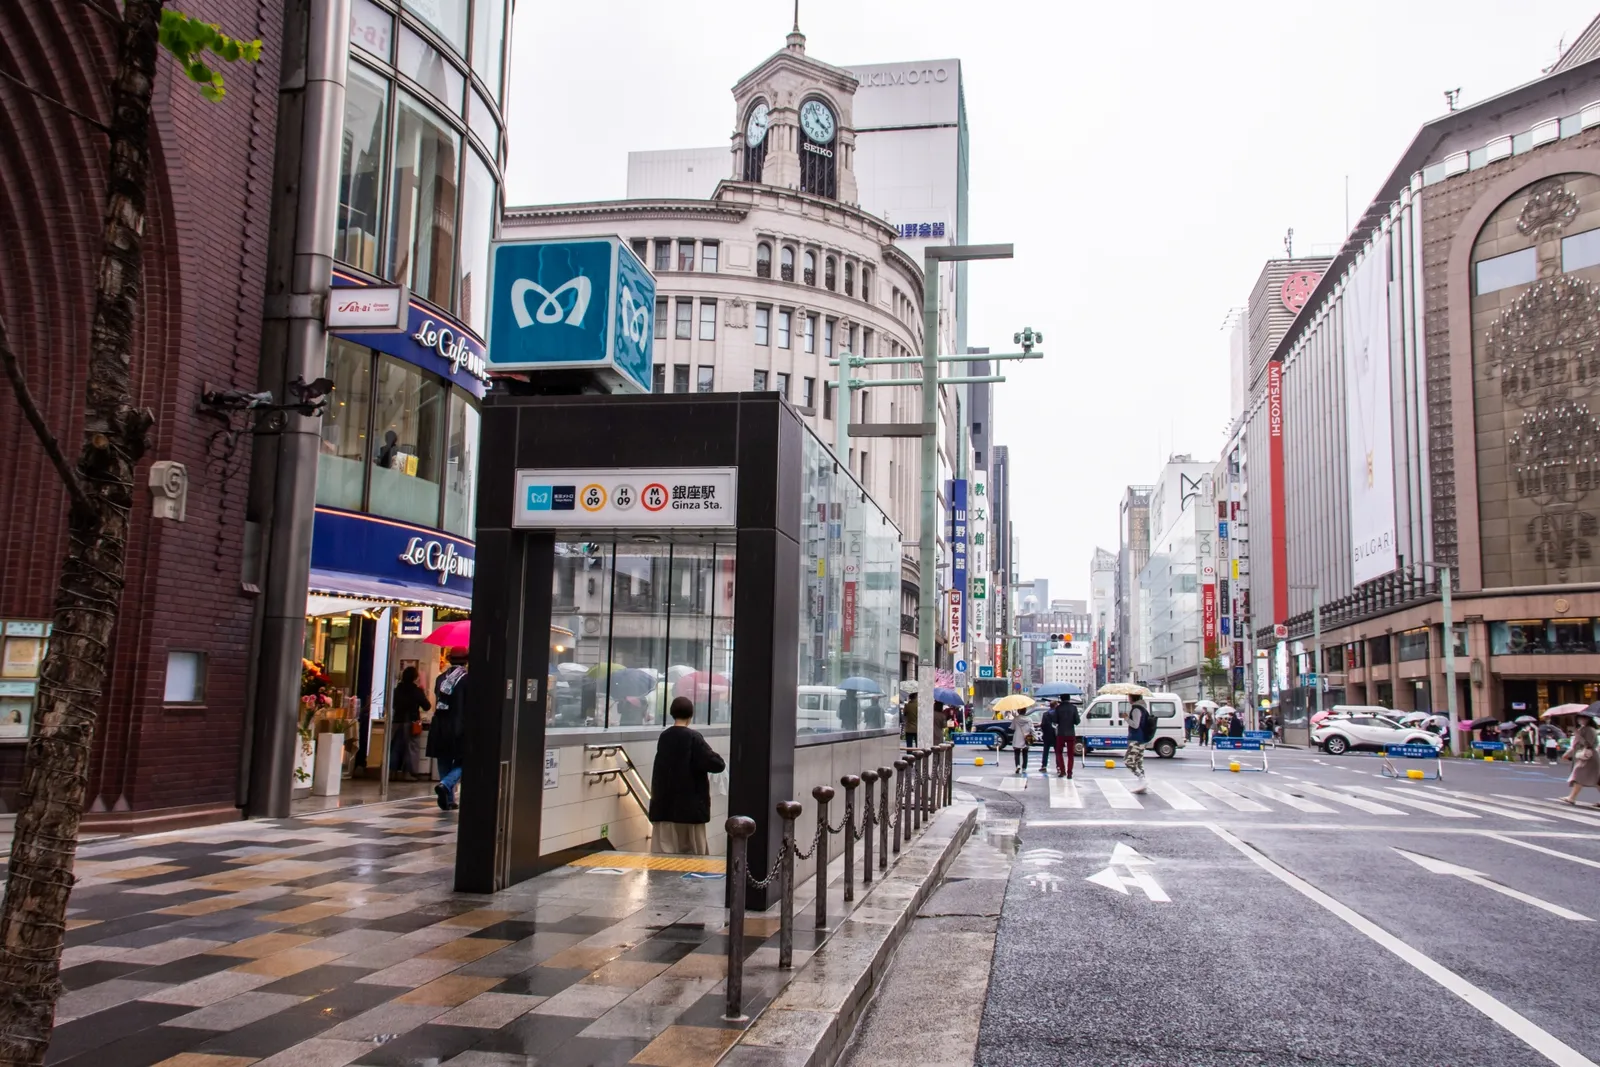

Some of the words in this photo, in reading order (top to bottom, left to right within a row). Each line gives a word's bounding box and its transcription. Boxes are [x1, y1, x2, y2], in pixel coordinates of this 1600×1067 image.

[853, 68, 948, 87] IKIMOTO
[803, 142, 833, 158] SEIKO
[413, 319, 438, 347] Le
[437, 328, 469, 374] Café
[1270, 367, 1281, 437] MITSUKOSHI
[590, 488, 598, 497] G
[620, 488, 628, 497] H
[650, 488, 660, 496] M
[672, 485, 715, 500] 銀座駅
[586, 497, 600, 506] 09
[617, 496, 631, 506] 09
[649, 496, 661, 506] 16
[672, 500, 700, 511] Ginza
[703, 500, 722, 510] Sta.
[974, 483, 985, 546] 教文館
[955, 509, 966, 570] 山野楽器
[1355, 529, 1393, 562] BVLGARI
[401, 537, 425, 565] Le
[424, 541, 458, 585] Café
[973, 581, 985, 596] 本
